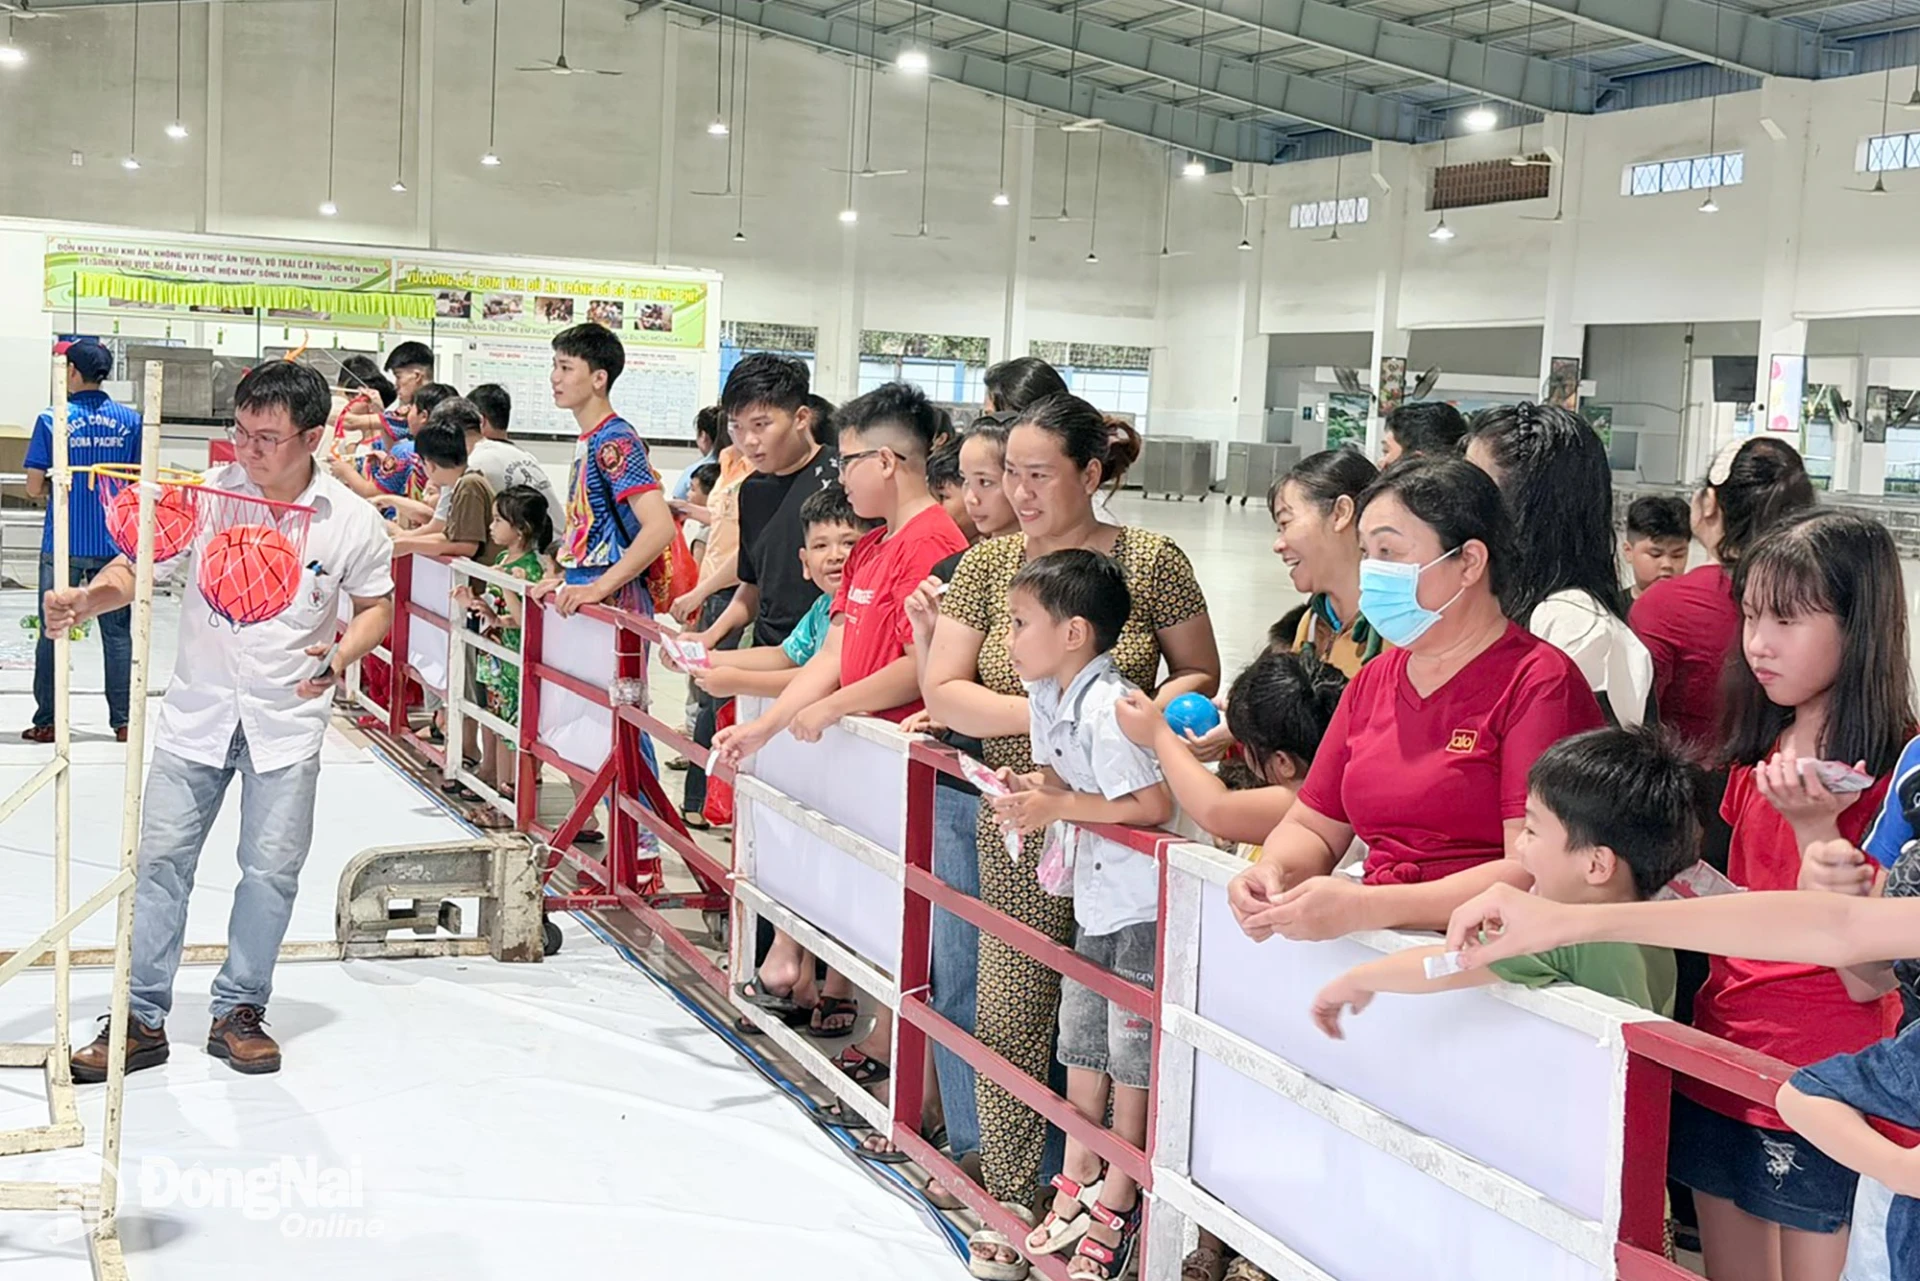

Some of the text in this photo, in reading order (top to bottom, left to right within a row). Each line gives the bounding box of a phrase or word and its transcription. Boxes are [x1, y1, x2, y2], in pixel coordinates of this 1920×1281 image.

[78, 245, 99, 253] KHAY
[102, 246, 119, 254] SAU
[121, 247, 135, 255] KHI
[154, 249, 182, 259] KHÔNG
[226, 253, 238, 263] ĂN
[298, 259, 313, 269] CÂY
[115, 259, 132, 268] KHU
[175, 263, 187, 272] ĂN
[219, 267, 238, 276] HIỆN
[283, 271, 299, 280] VĂN
[301, 273, 322, 281] MINH
[544, 278, 558, 293] ĂN
[561, 280, 593, 295] TRÁNH
[118, 423, 131, 436] TY
[93, 436, 124, 448] PACIFIC
